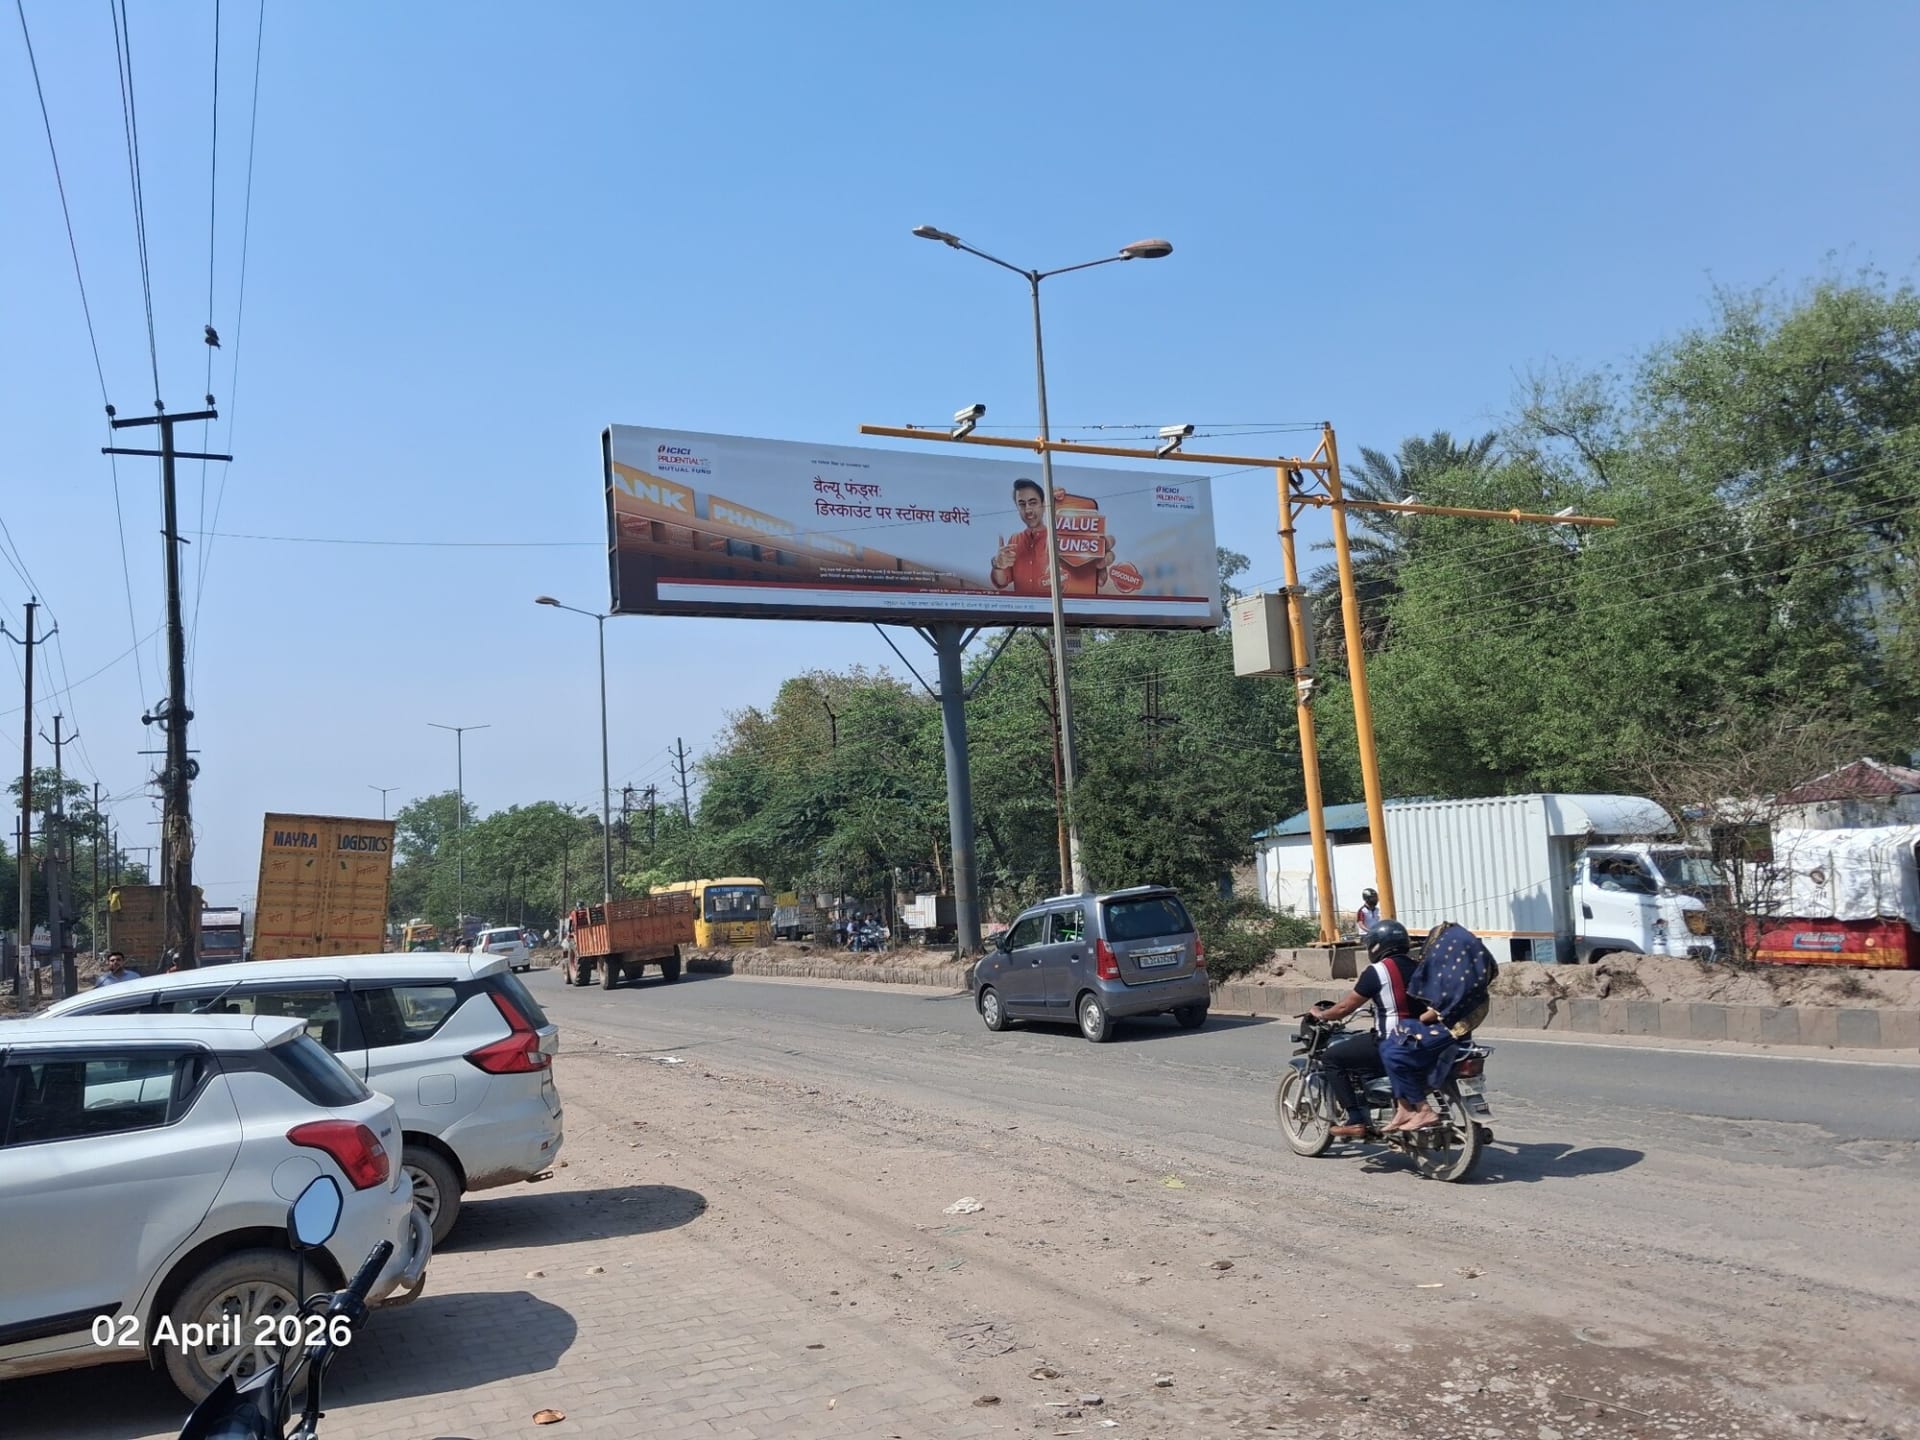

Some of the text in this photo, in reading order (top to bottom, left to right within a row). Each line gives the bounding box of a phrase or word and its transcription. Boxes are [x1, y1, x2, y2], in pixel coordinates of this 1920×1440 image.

[667, 447, 691, 455] ICICI
[813, 476, 845, 500] वैल्यू
[815, 498, 971, 526] डिस्काउंट पर स्टॉक्स खरीदें
[1056, 538, 1099, 552] UNDS
[1111, 569, 1141, 586] DISCOUNT
[273, 831, 388, 852] MAYRA LOGISTICS
